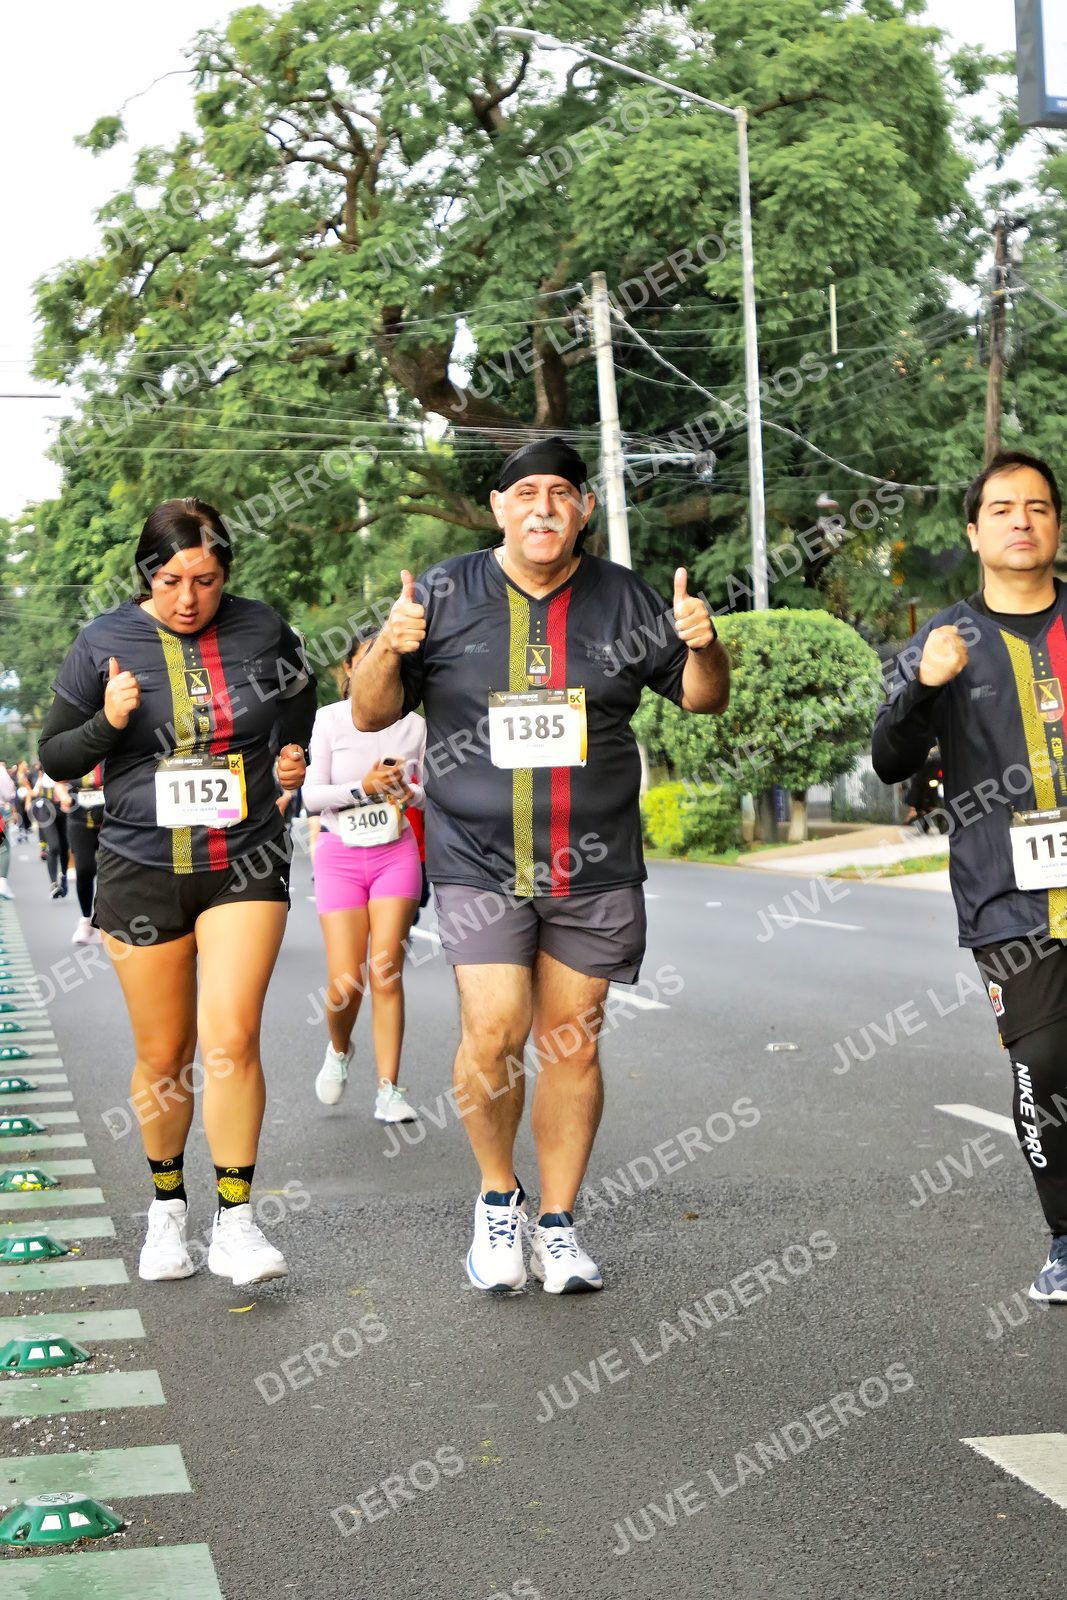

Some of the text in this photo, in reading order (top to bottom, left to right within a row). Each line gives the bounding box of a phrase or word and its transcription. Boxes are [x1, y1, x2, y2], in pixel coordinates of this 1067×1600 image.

[503, 715, 565, 740] 1385
[169, 779, 228, 804] 1152
[347, 809, 388, 832] 3400
[1016, 1062, 1048, 1168] NIKE PRO
